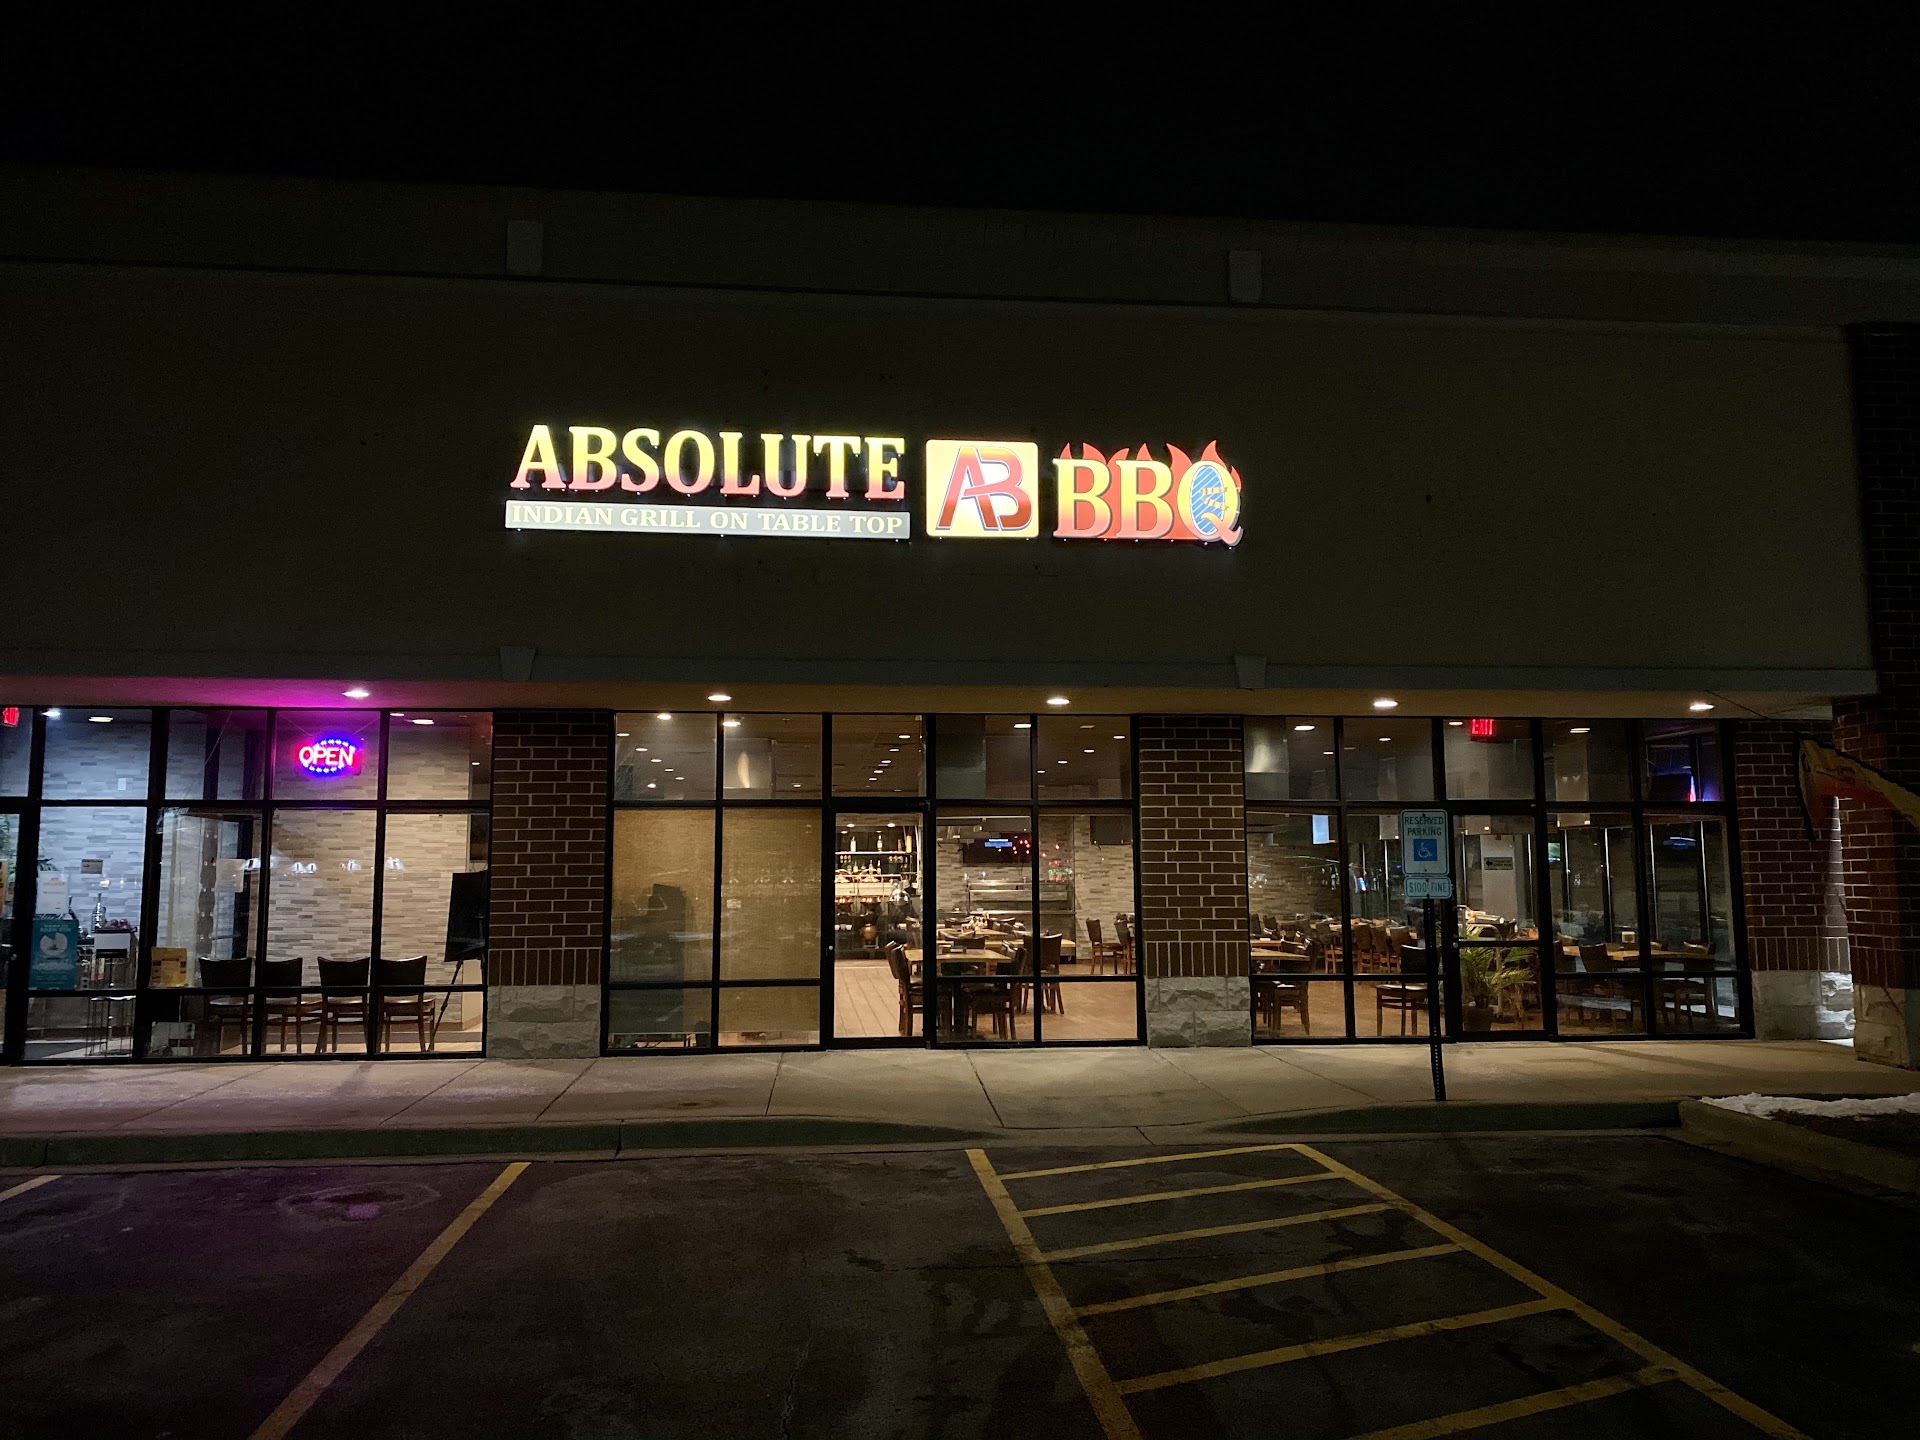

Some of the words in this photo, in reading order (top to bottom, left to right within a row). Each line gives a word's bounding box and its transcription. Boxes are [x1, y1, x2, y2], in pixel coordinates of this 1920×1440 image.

[510, 424, 906, 500] ABSOLUTE
[935, 445, 1033, 531] AB
[1052, 457, 1244, 547] BBQ
[511, 503, 614, 526] INDIAN
[620, 508, 701, 529] GRILL
[709, 510, 748, 530] ON
[757, 513, 841, 533] TABLE
[848, 515, 903, 535] TOP
[1471, 718, 1495, 735] EXIT
[298, 745, 355, 767] OPEN
[1404, 816, 1444, 826] RESERVED
[1407, 827, 1442, 836] PARKING
[1431, 882, 1447, 893] FINE
